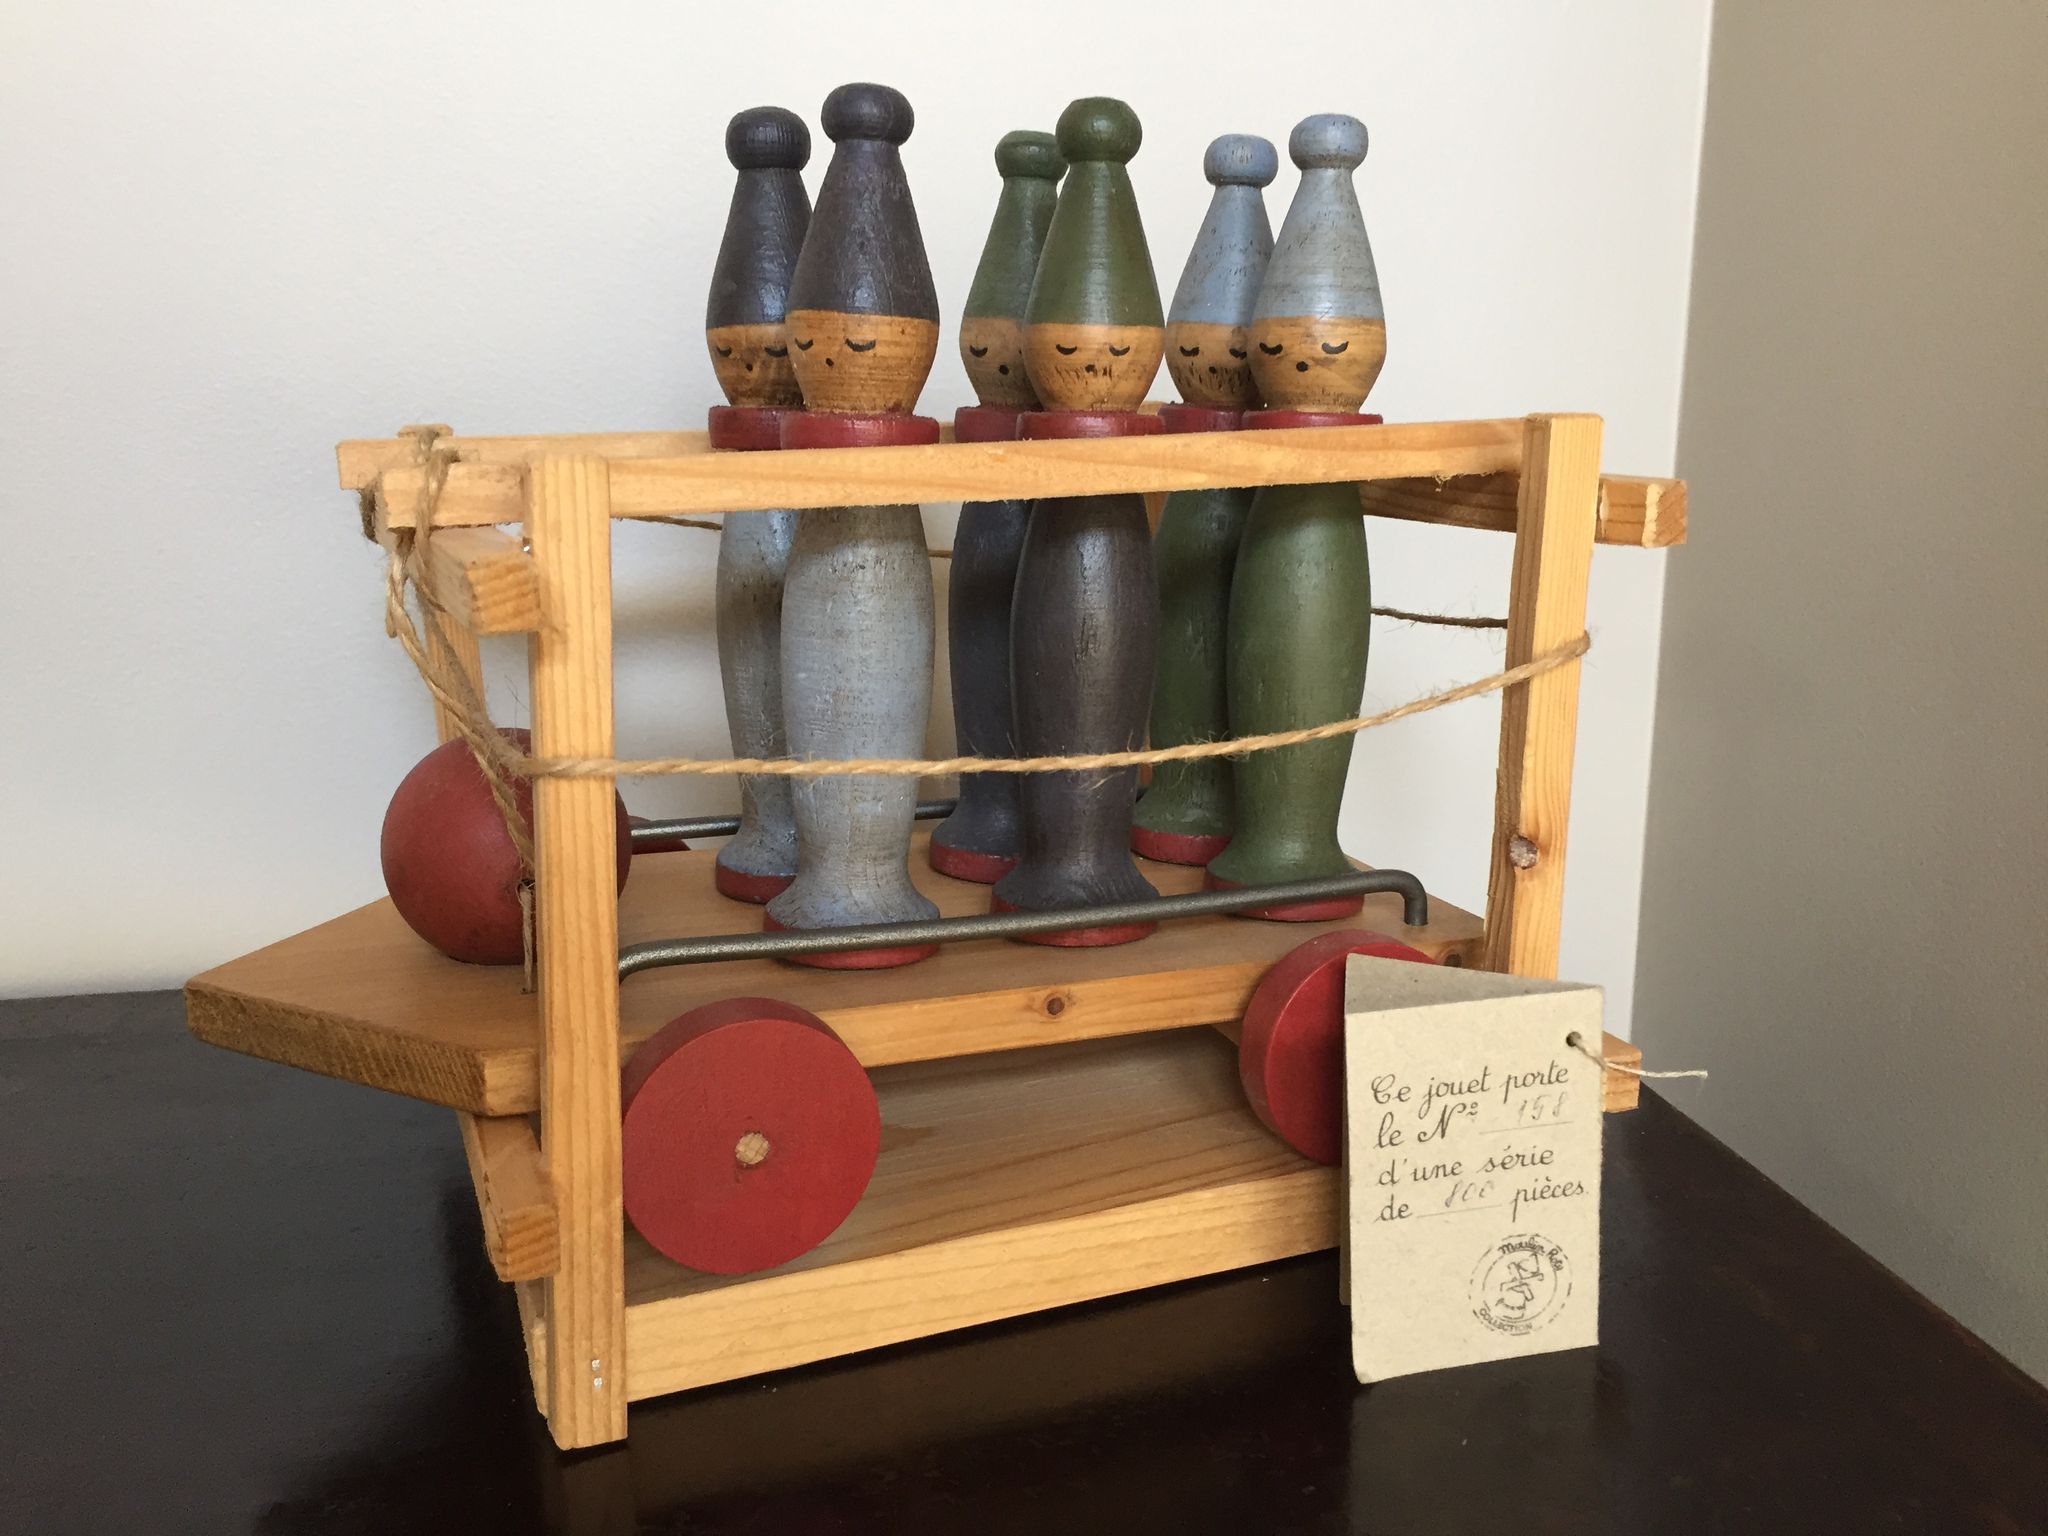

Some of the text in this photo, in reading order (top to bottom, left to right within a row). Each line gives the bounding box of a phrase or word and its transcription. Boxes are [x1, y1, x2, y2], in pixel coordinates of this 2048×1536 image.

[1371, 1060, 1569, 1120] Ce jouet porte
[1373, 1112, 1405, 1149] le
[1375, 1146, 1554, 1186] d'une série
[1373, 1194, 1413, 1223] de
[1479, 1308, 1533, 1332] COLLECTION
